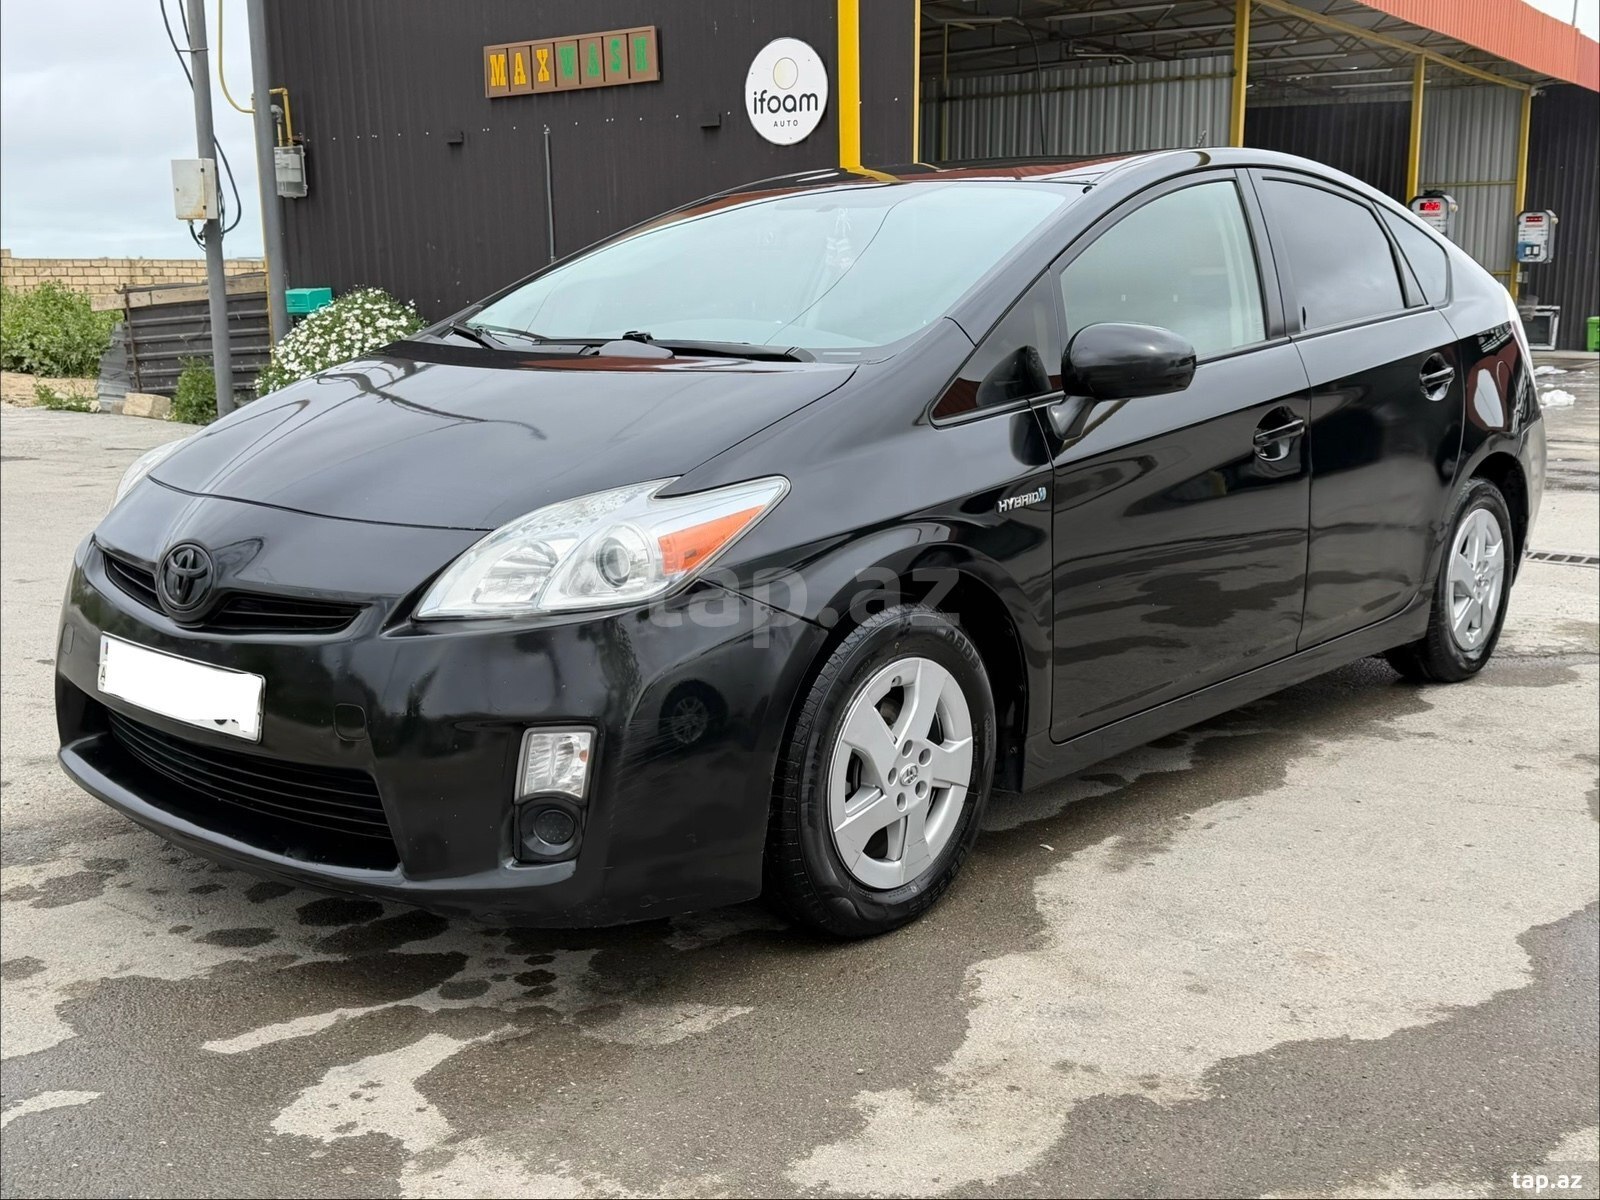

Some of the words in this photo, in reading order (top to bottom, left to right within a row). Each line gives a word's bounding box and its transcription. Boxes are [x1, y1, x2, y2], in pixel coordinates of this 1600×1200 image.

[753, 90, 818, 114] ifoam
[772, 119, 801, 128] AUTO
[998, 492, 1039, 512] HYBRID
